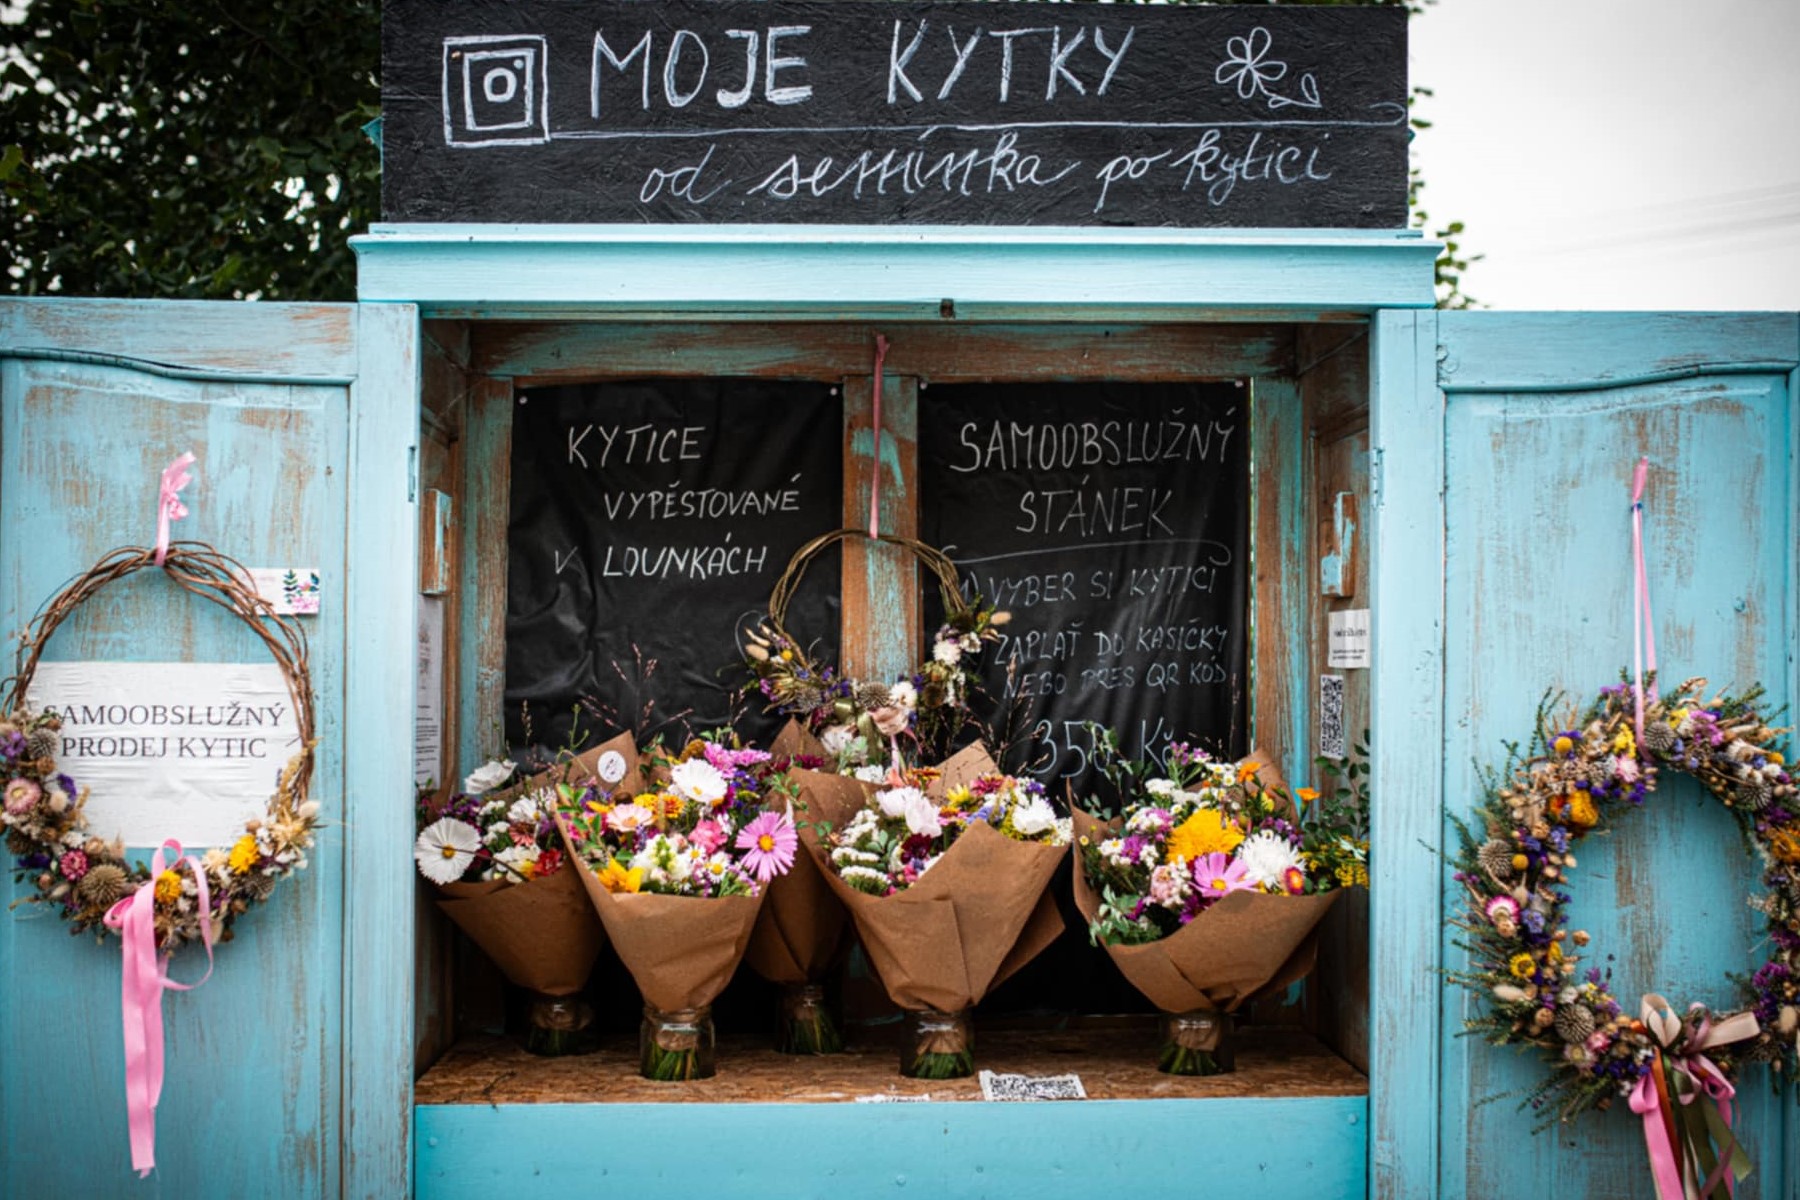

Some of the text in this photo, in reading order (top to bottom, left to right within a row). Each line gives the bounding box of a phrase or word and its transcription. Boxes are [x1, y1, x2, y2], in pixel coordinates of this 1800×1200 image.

[591, 18, 1135, 118] MOJE KYTKY
[640, 126, 1332, 213] od semínka po kytici
[568, 424, 706, 468] KYTICE
[949, 406, 1236, 472] SAMOOBSLUŽNÝ
[604, 473, 801, 520] VYPĚSTOVANÉ
[1016, 474, 1175, 537] STÁNEK
[602, 532, 767, 580] LOUNKÁCH
[989, 571, 1077, 606] VYBER
[1090, 570, 1113, 599] SI
[1130, 565, 1217, 596] KYTICI
[994, 616, 1229, 665] ZAPLAŤ DO KASIČKY
[1003, 667, 1068, 700] NEBO
[1146, 661, 1180, 693] QR
[1188, 655, 1227, 684] KÓD
[61, 736, 268, 758] PRODEJ KYTIC
